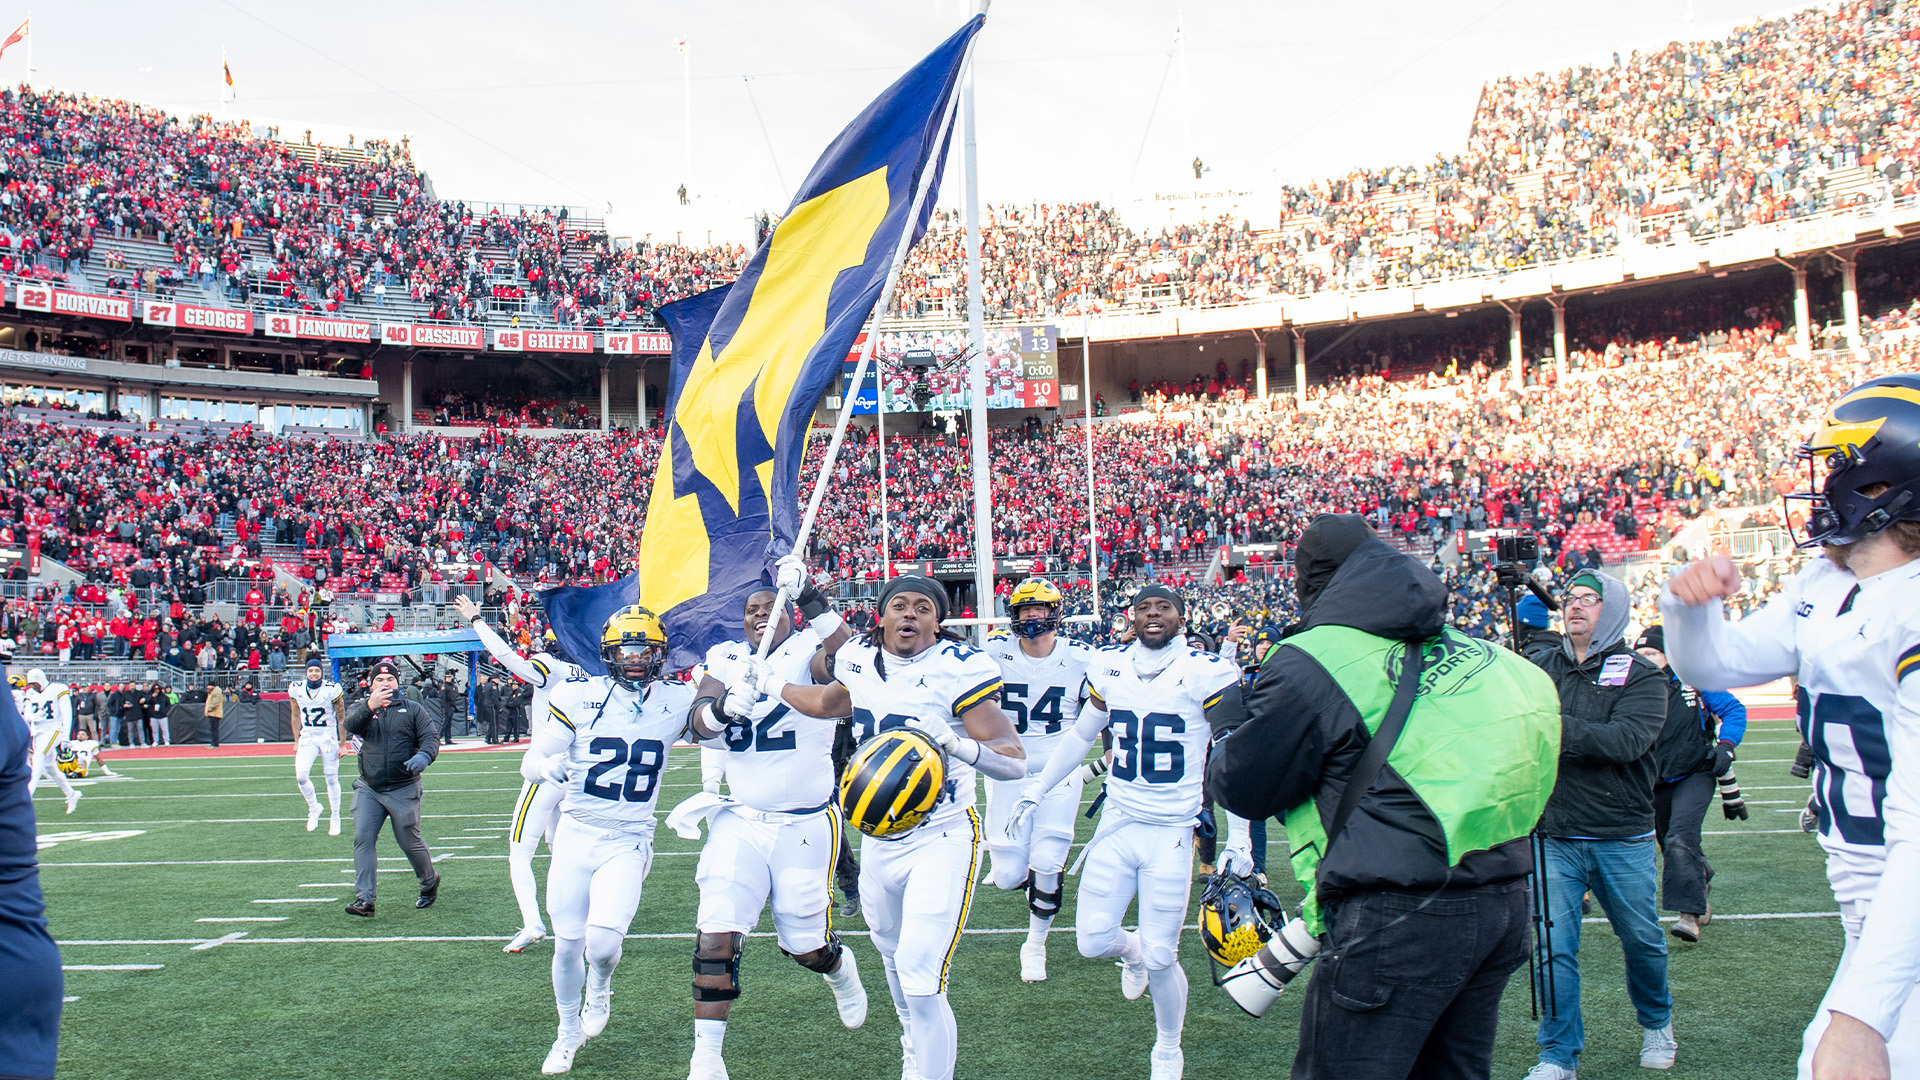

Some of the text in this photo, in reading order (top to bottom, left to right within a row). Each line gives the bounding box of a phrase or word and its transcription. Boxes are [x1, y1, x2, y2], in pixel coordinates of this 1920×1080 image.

[23, 289, 129, 319] 22 HORVATH
[149, 305, 246, 330] 27 GEORGE
[271, 317, 370, 340] 31 JANOWICZ
[386, 326, 479, 346] 40 CASSADY
[498, 332, 589, 350] 45 GRIFFIN
[608, 336, 673, 351] 47 HAR
[1031, 337, 1049, 351] 13
[34, 355, 86, 369] LANDING
[1028, 365, 1053, 376] 0:00
[1032, 382, 1051, 396] 10
[1418, 647, 1482, 697] SPORTS
[302, 707, 328, 727] 12
[1003, 683, 1066, 734] 54
[1109, 709, 1186, 783] 36
[584, 737, 664, 802] 28
